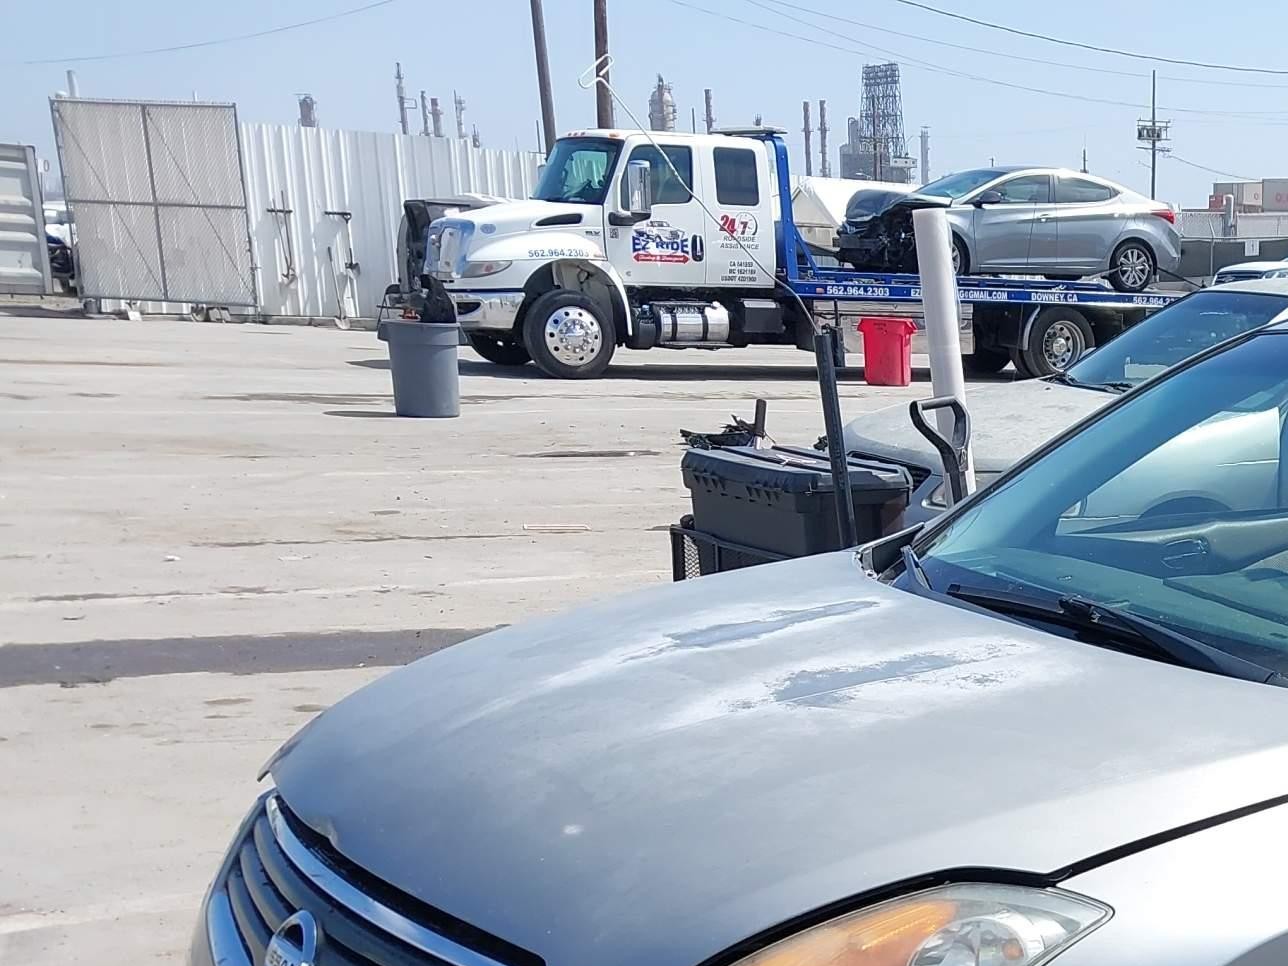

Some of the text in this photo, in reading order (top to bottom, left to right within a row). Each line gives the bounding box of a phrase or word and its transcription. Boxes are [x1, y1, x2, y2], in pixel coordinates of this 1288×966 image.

[631, 235, 689, 255] EZ RIDE
[528, 248, 589, 258] 562.964.2303
[826, 285, 890, 296] 562.964.2303
[1067, 293, 1079, 302] CA
[1132, 295, 1179, 306] 562.964.2
